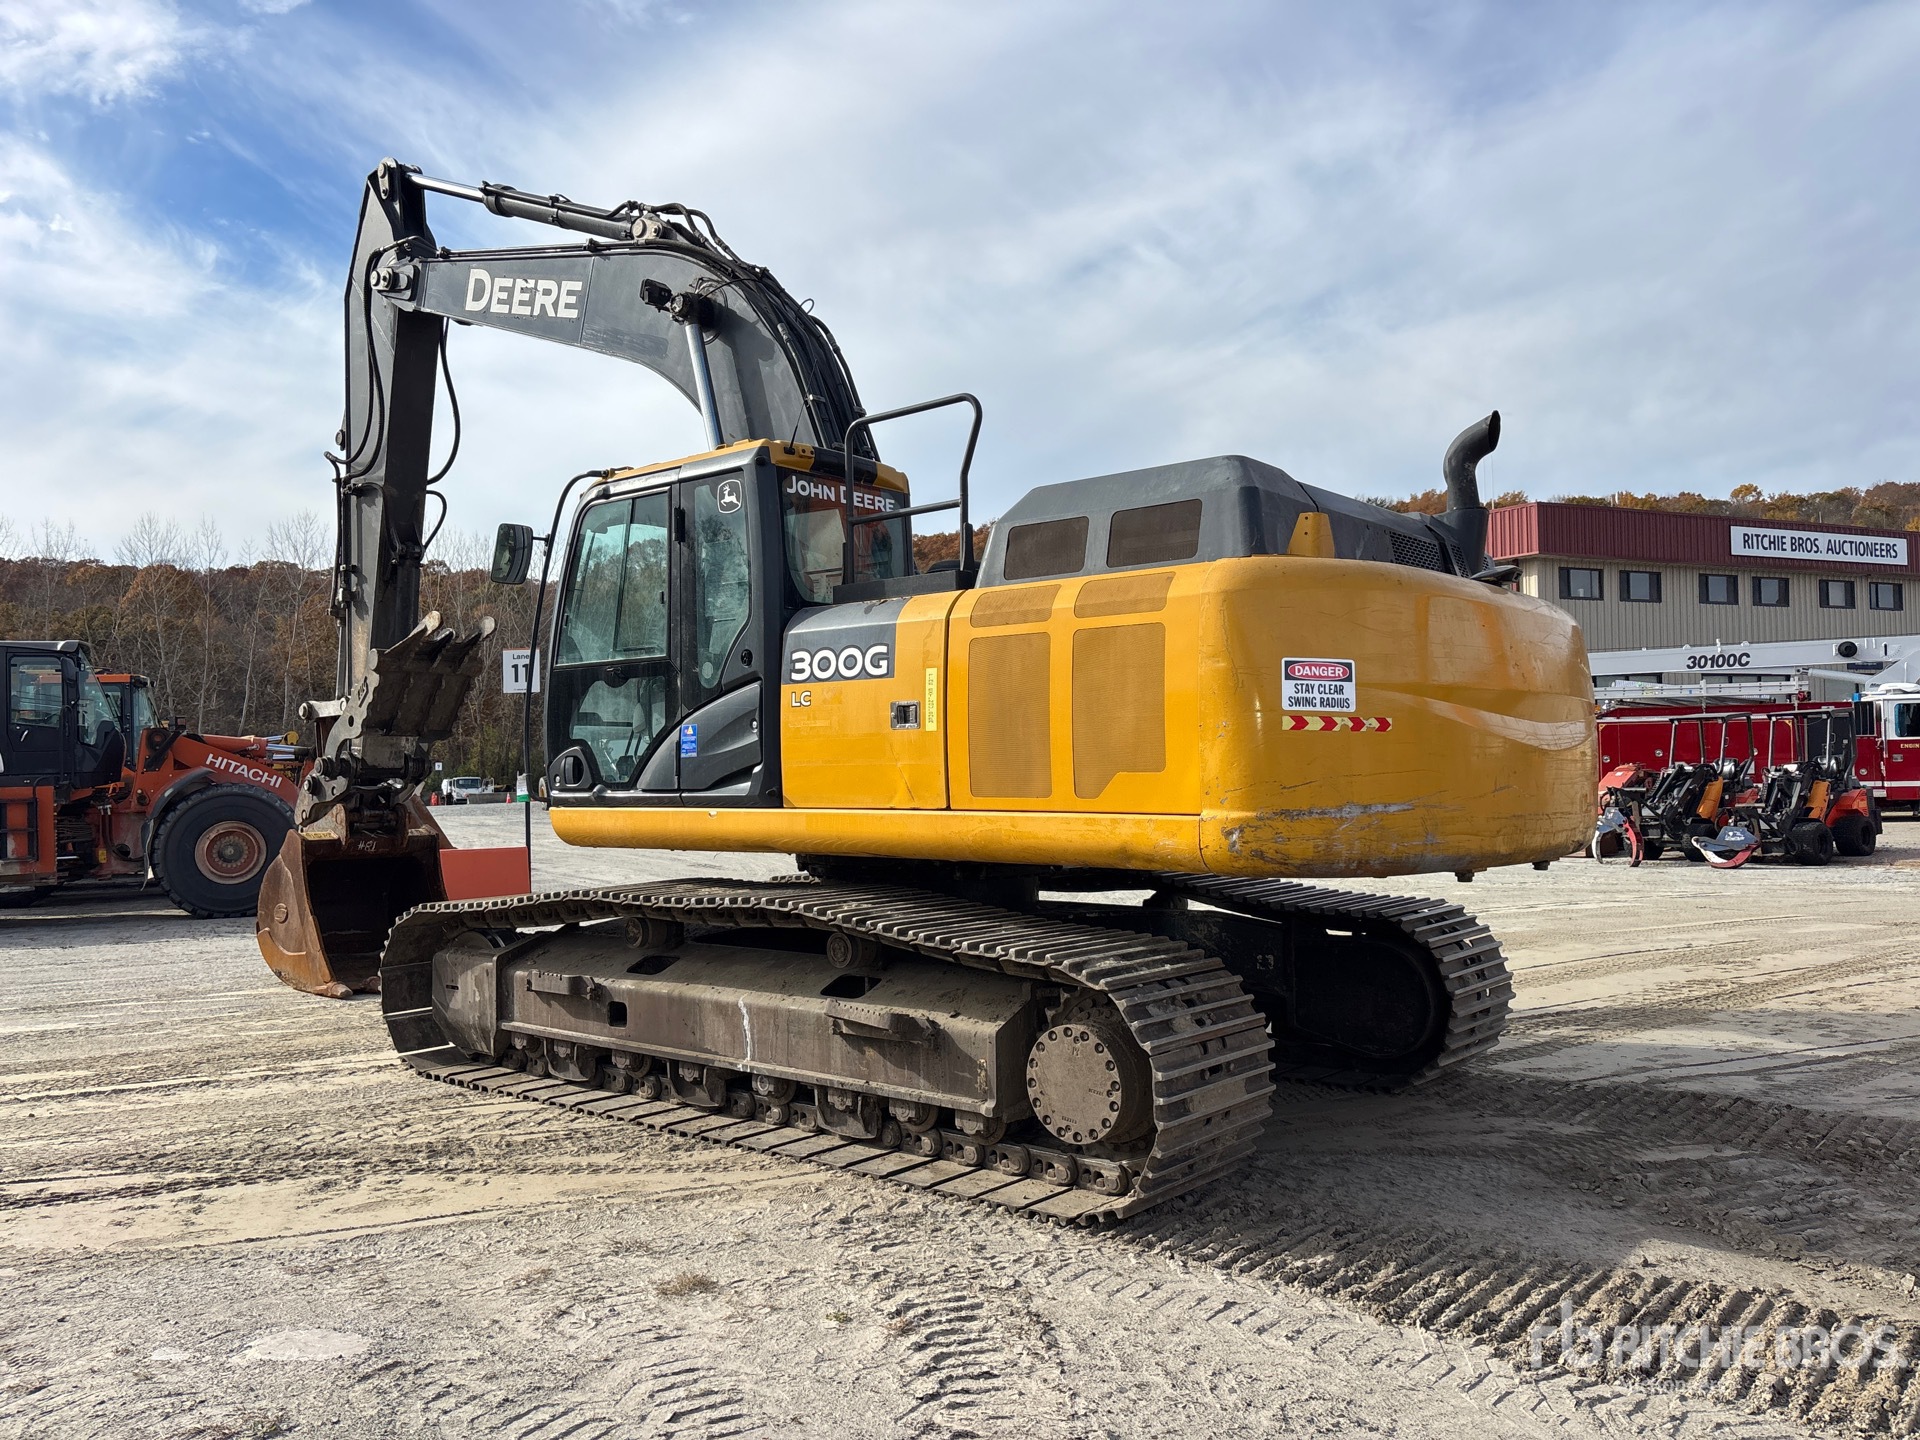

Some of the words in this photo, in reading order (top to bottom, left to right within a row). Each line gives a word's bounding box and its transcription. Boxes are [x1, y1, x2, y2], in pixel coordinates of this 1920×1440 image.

[465, 268, 583, 318] DEERE
[786, 475, 836, 502] JOHN
[1742, 533, 1787, 552] RITCHIE
[1790, 536, 1823, 554] BROS.
[1826, 538, 1898, 559] AUCTIONEERS
[790, 644, 889, 682] 300G
[1294, 665, 1344, 677] DANGER
[1686, 652, 1751, 669] 30100C
[790, 691, 812, 707] LC
[1293, 683, 1316, 695] STAY
[1317, 684, 1345, 696] CLEAR
[1287, 696, 1317, 708] SWING
[1319, 697, 1351, 709] RADIUS
[205, 753, 283, 788] HITACHI
